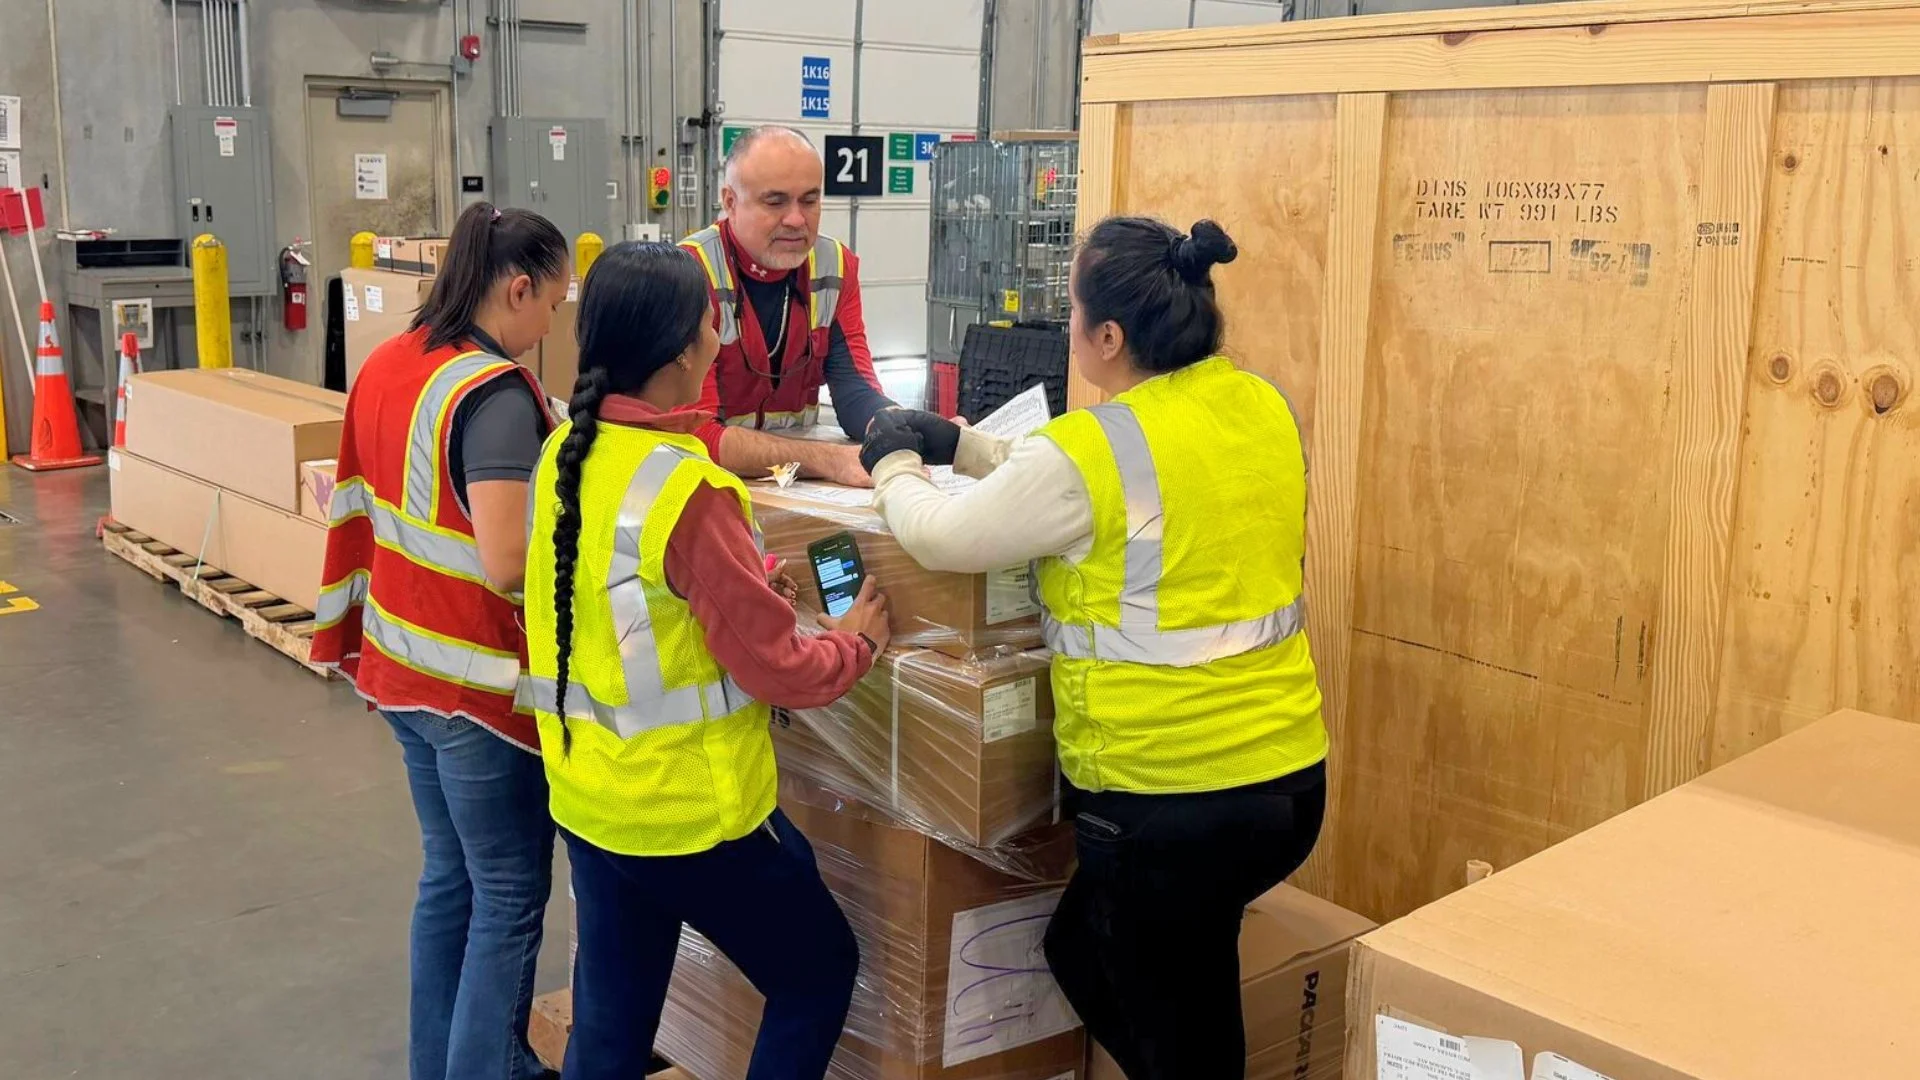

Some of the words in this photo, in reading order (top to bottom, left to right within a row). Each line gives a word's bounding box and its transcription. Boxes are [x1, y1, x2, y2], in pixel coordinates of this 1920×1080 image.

[803, 65, 829, 80] 1K16
[802, 96, 829, 111] 1K15
[836, 147, 868, 183] 21
[1416, 179, 1467, 198] DIMS
[1485, 180, 1605, 201] 106X83X77
[1415, 201, 1466, 220] TARE
[1520, 204, 1556, 222] 991
[1575, 205, 1619, 224] LBS
